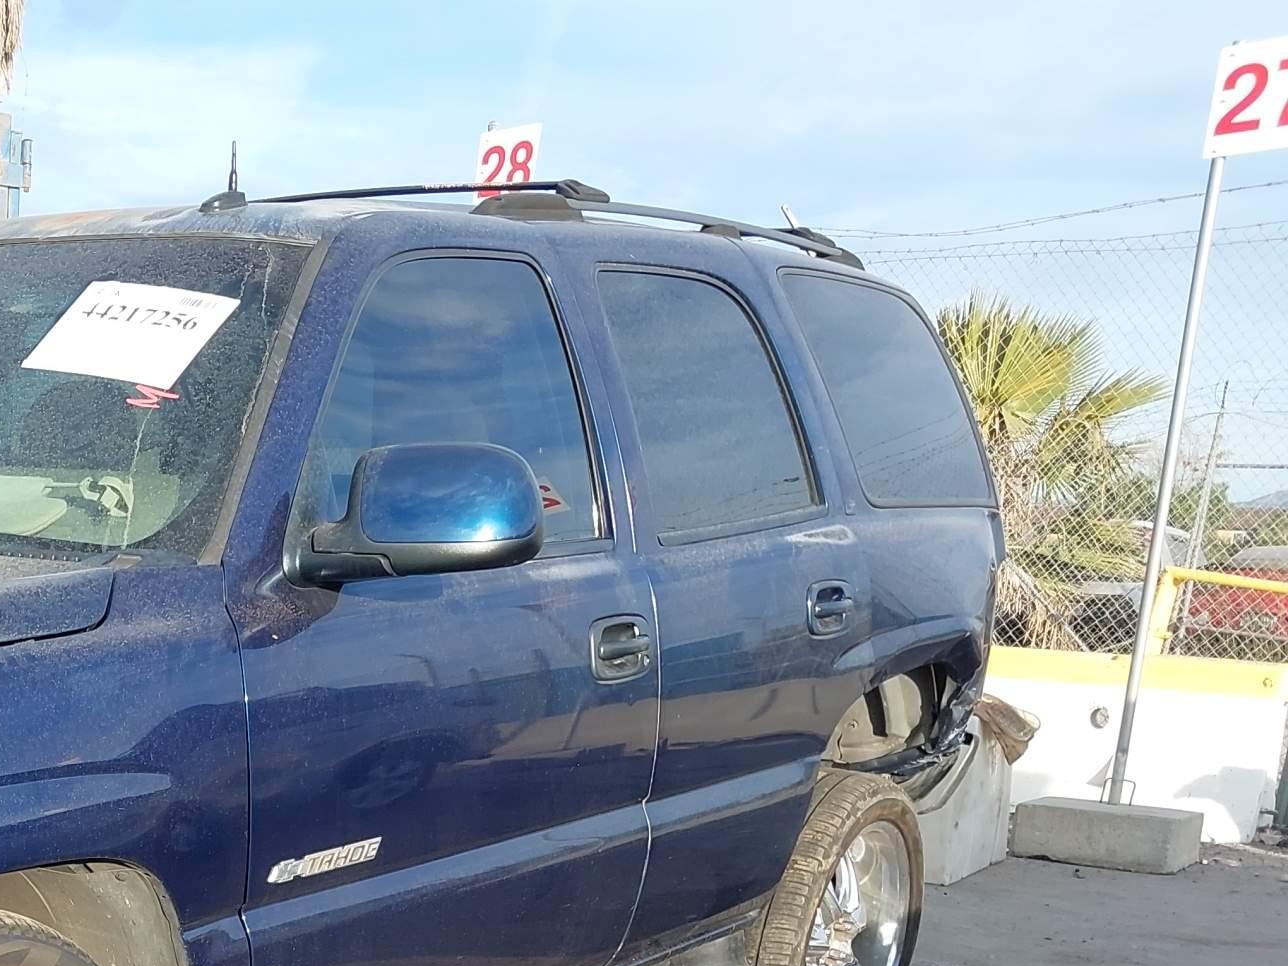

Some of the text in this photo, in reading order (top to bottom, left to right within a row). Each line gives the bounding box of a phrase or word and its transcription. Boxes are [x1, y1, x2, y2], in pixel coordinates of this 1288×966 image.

[1214, 58, 1288, 136] 2
[476, 140, 534, 198] 28
[82, 302, 198, 331] 44217256
[305, 837, 382, 876] TAHOE
